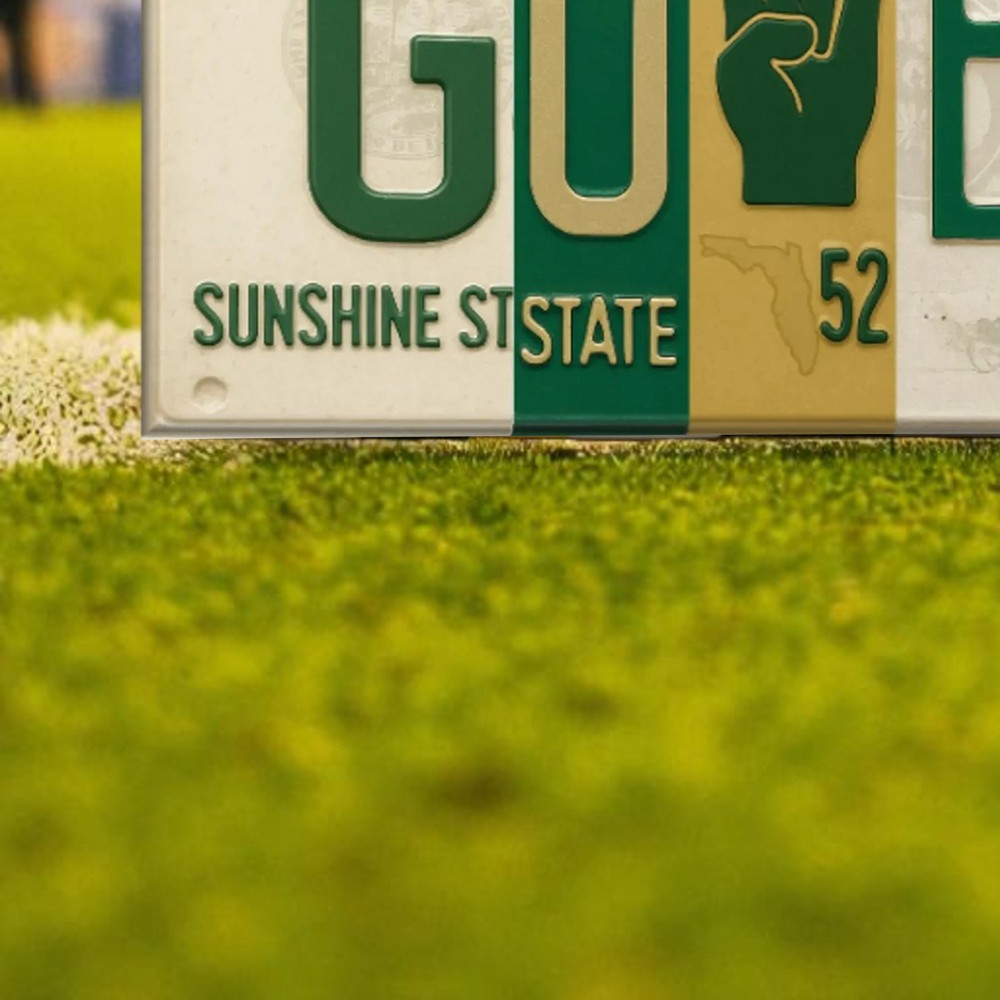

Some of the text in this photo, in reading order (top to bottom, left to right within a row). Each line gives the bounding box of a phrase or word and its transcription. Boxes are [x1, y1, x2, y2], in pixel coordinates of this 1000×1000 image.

[193, 281, 440, 349] SUNSHINE
[520, 294, 678, 367] STATE
[820, 247, 889, 344] 52
